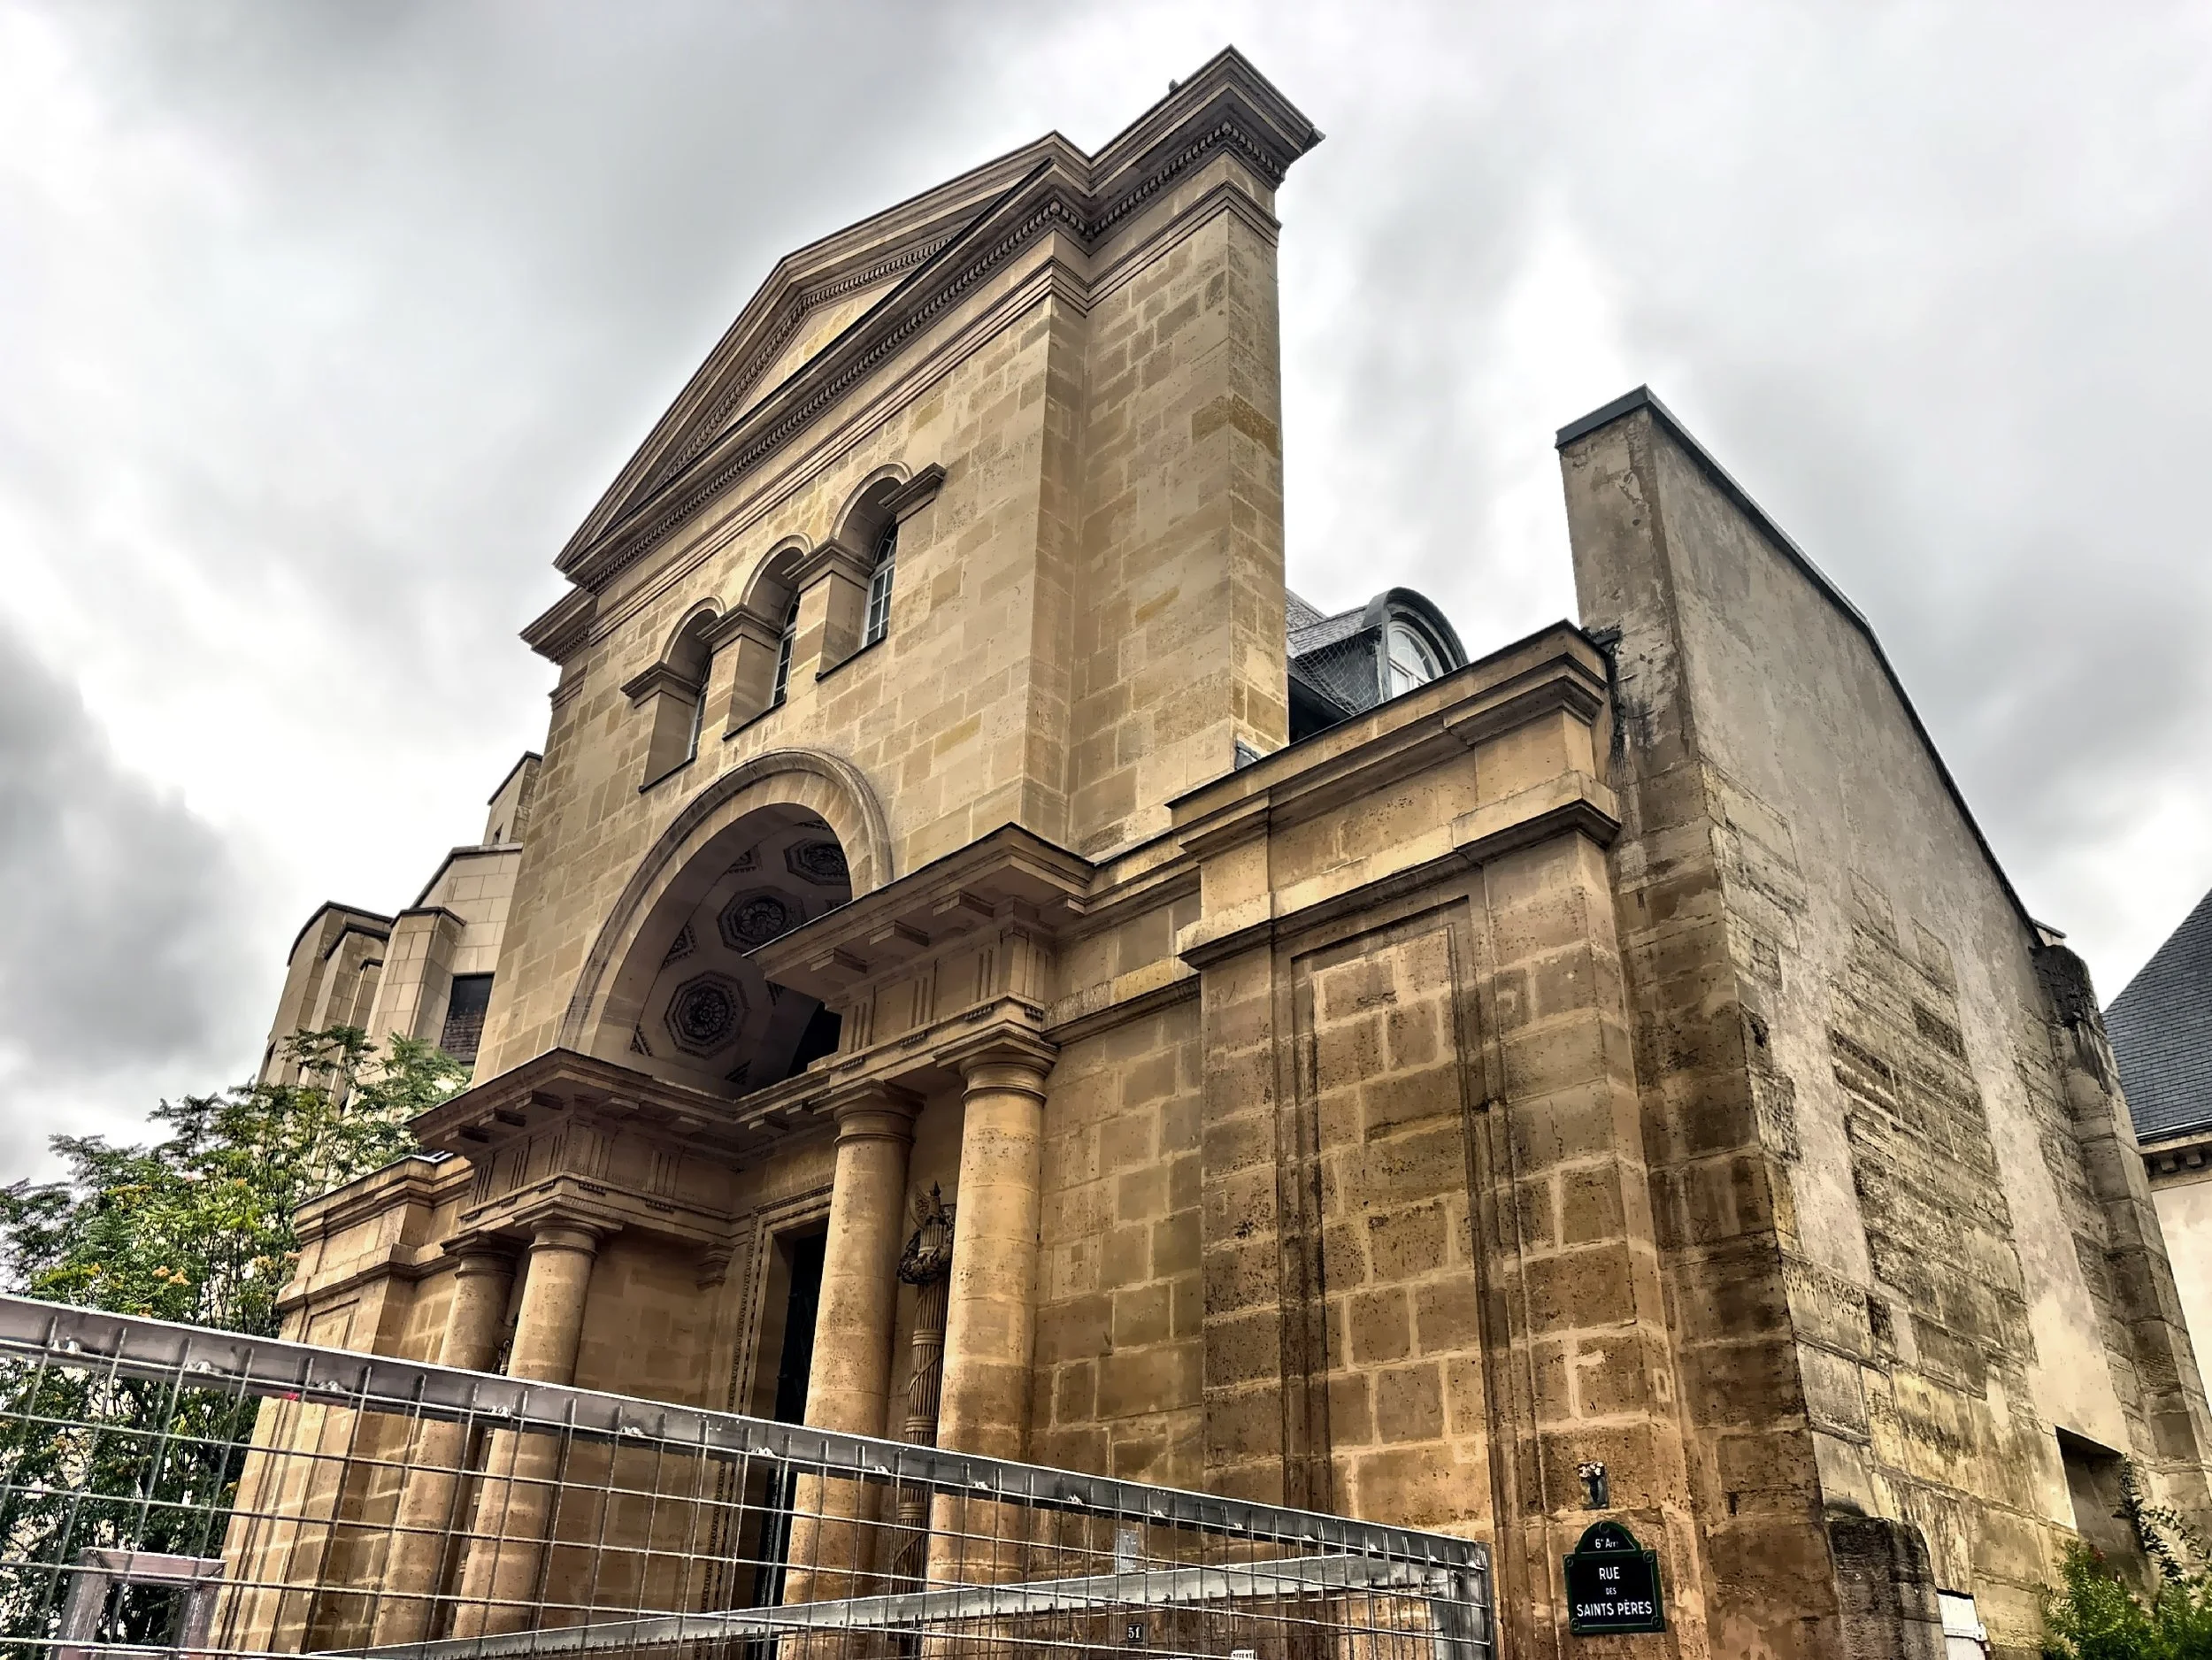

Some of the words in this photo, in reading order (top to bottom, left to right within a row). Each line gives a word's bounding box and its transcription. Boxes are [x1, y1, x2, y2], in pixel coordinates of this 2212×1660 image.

[1599, 1566, 1621, 1580] RUE
[1605, 1587, 1617, 1595] DES
[1576, 1602, 1615, 1618] SAINTS
[1617, 1599, 1653, 1616] PÈRES
[1127, 1626, 1141, 1639] 51
